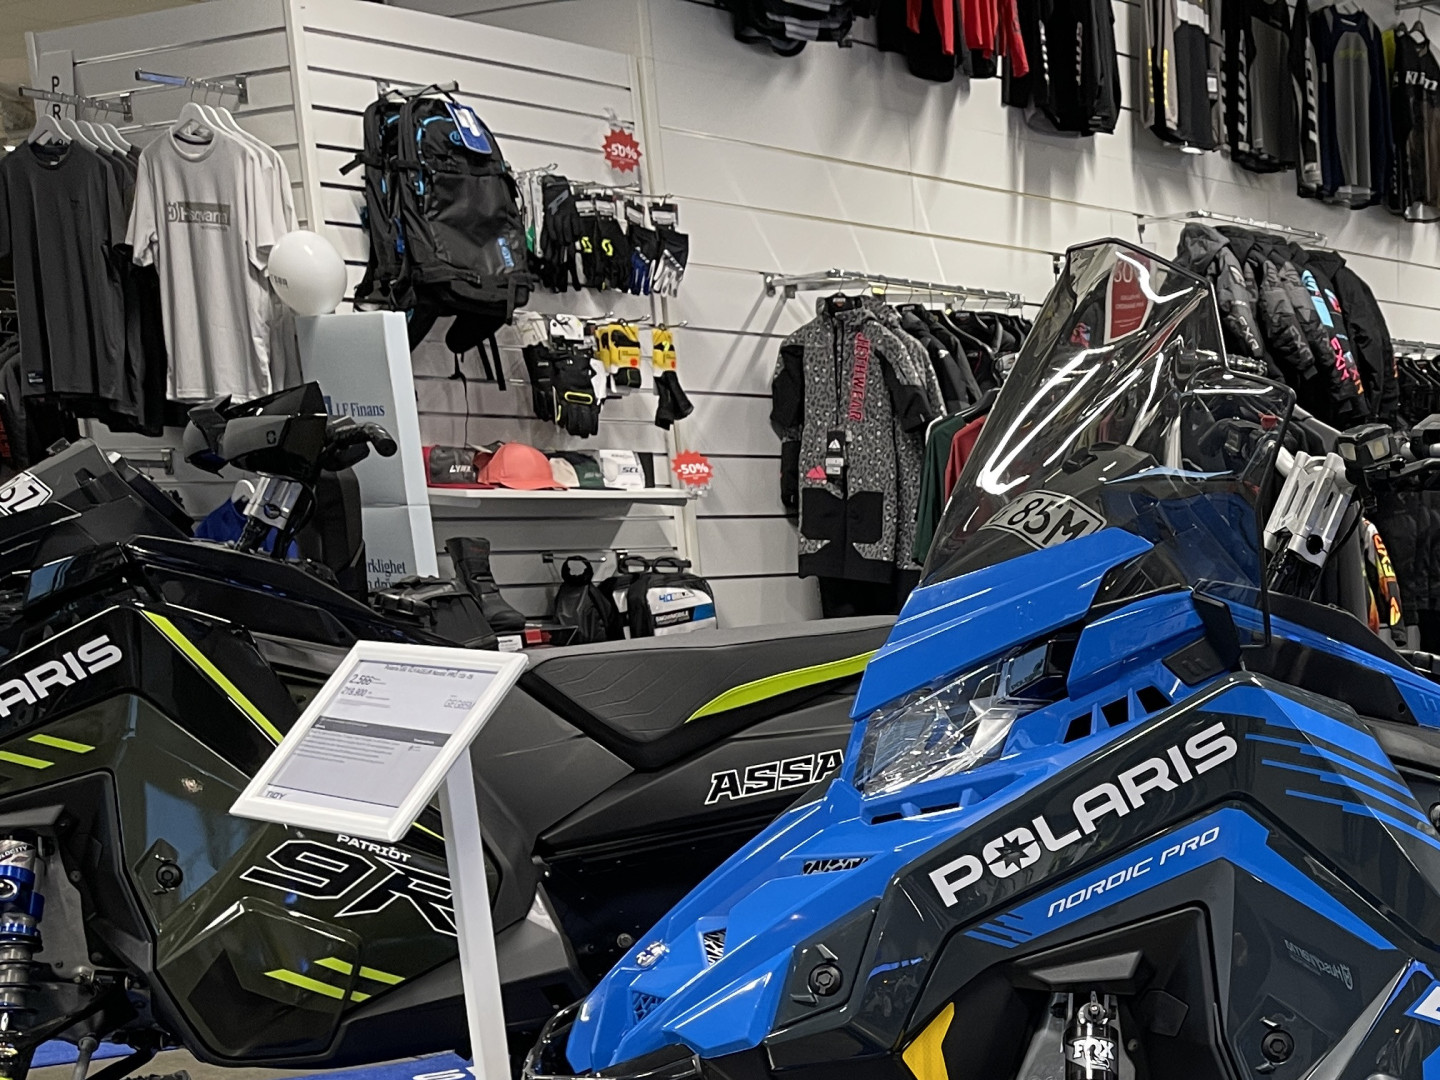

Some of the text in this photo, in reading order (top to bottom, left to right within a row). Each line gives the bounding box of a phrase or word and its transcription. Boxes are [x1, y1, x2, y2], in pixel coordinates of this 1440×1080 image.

[848, 331, 871, 422] JETHWEAR
[350, 402, 386, 418] Finans
[677, 462, 709, 475] -50%
[703, 748, 845, 806] ASSA
[928, 721, 1238, 908] POLARIS
[336, 833, 412, 863] PATRIOT
[1047, 826, 1220, 918] NORDIC PRO
[1072, 1037, 1116, 1063] FOX
